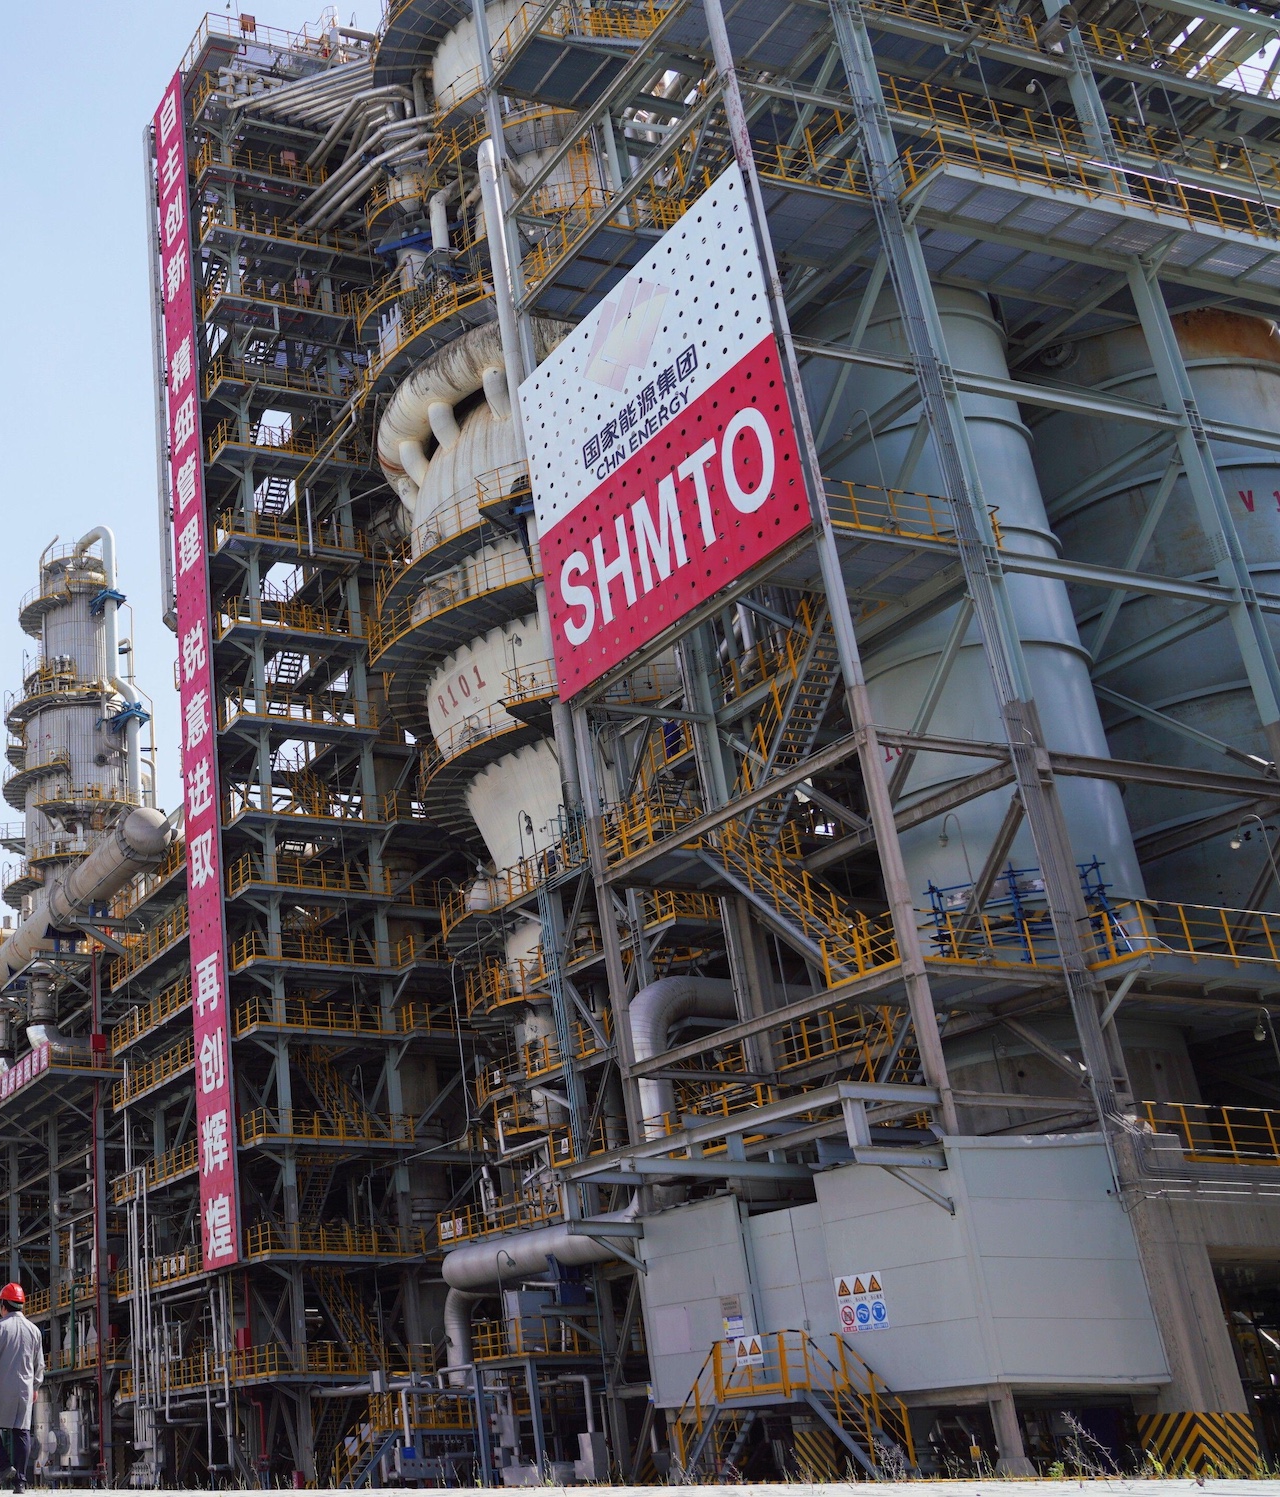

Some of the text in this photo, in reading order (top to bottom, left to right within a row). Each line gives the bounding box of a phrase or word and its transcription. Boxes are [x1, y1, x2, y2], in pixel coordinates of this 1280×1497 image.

[583, 344, 698, 469] 国家能源集团
[596, 386, 689, 480] CHN ENERGY
[560, 406, 775, 646] SHMTO
[159, 96, 234, 1262] 自主创新 精细管理 锐意进取 再创辉煌
[437, 665, 486, 718] R101
